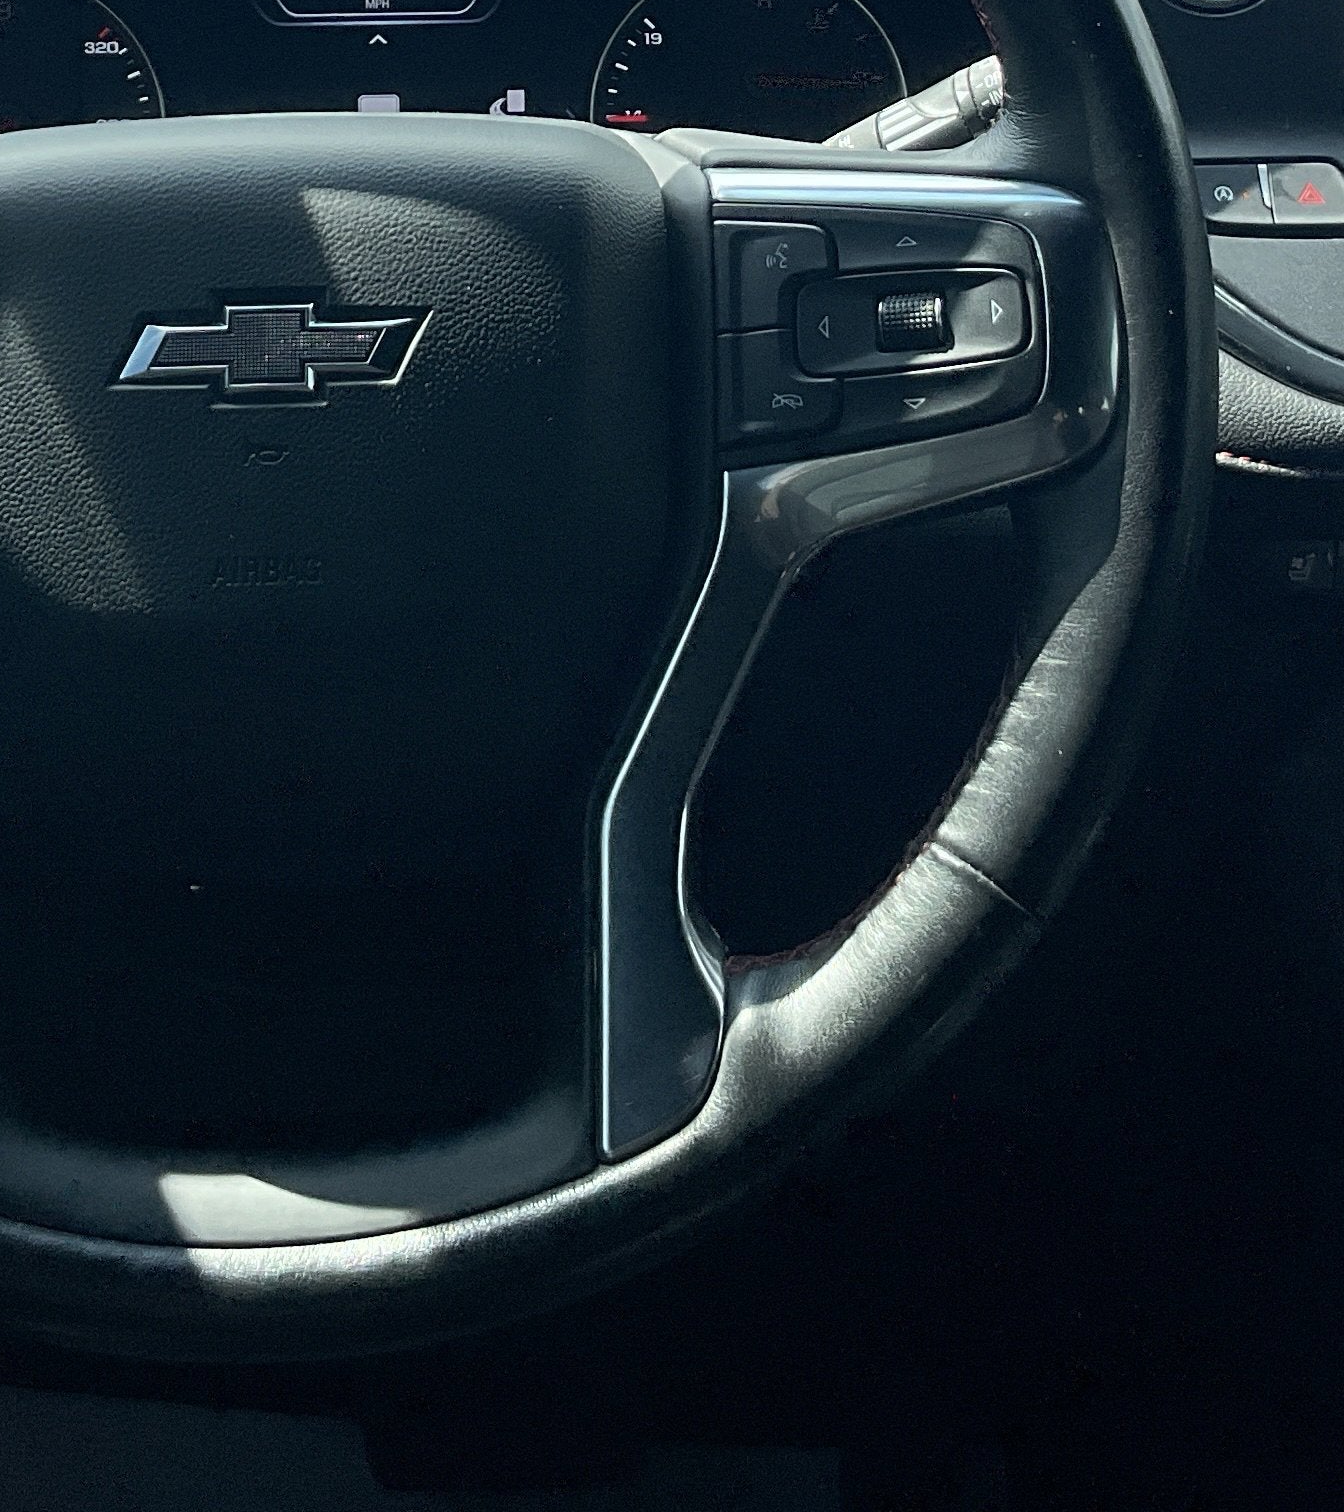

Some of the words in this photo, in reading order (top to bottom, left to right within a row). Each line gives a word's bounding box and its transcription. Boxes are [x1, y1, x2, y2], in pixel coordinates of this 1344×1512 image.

[644, 32, 663, 45] 19
[83, 39, 120, 55] 320
[211, 558, 323, 587] AIRBAG
